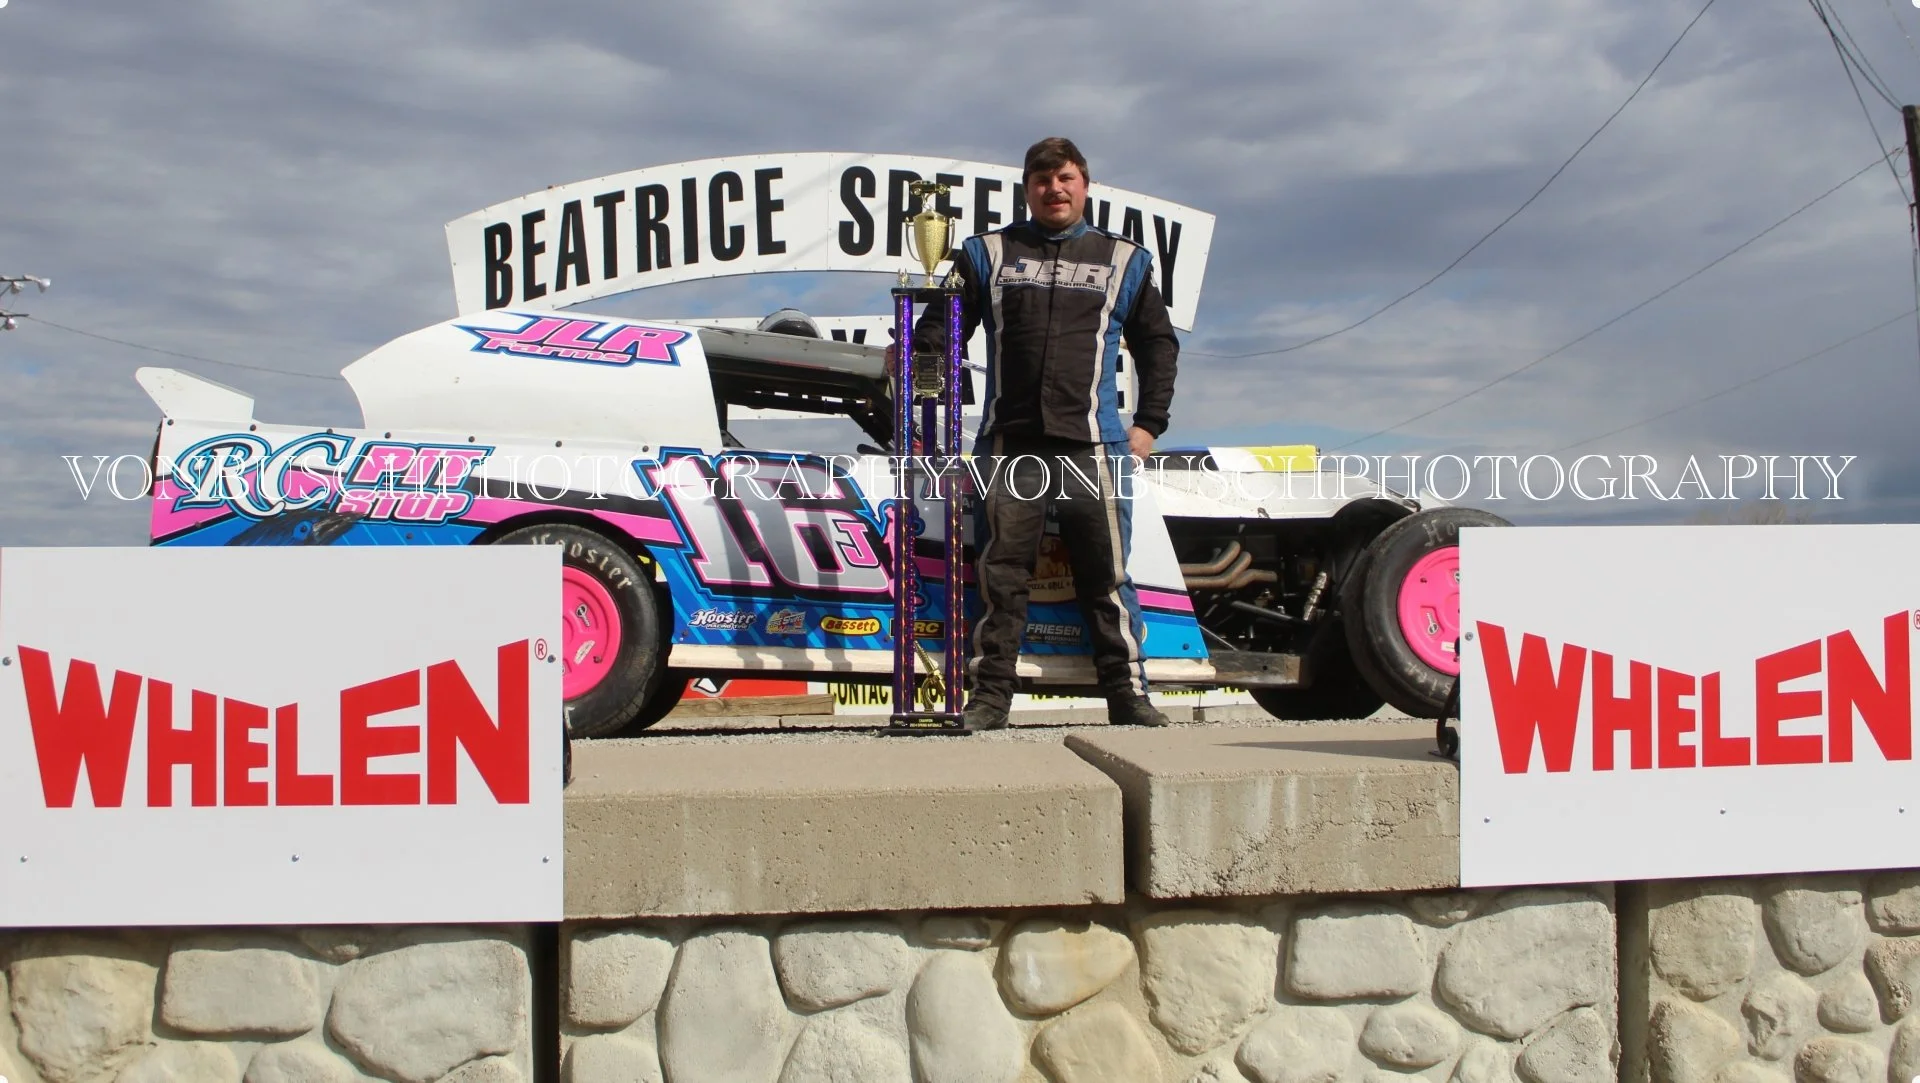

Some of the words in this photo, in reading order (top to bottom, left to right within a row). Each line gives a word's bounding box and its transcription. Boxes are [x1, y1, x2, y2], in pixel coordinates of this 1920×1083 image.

[484, 167, 787, 311] BEATRICE
[838, 165, 1182, 307] SPEEY
[1001, 258, 1113, 284] JSR
[475, 316, 685, 362] JLR
[483, 337, 632, 363] Farms
[172, 433, 354, 519] RC
[351, 445, 484, 487] PIT
[337, 487, 467, 521] STOP
[689, 607, 755, 625] Hoosier
[825, 618, 876, 632] Bassett
[1025, 623, 1082, 636] FRIESEN
[827, 682, 889, 706] CONTAC
